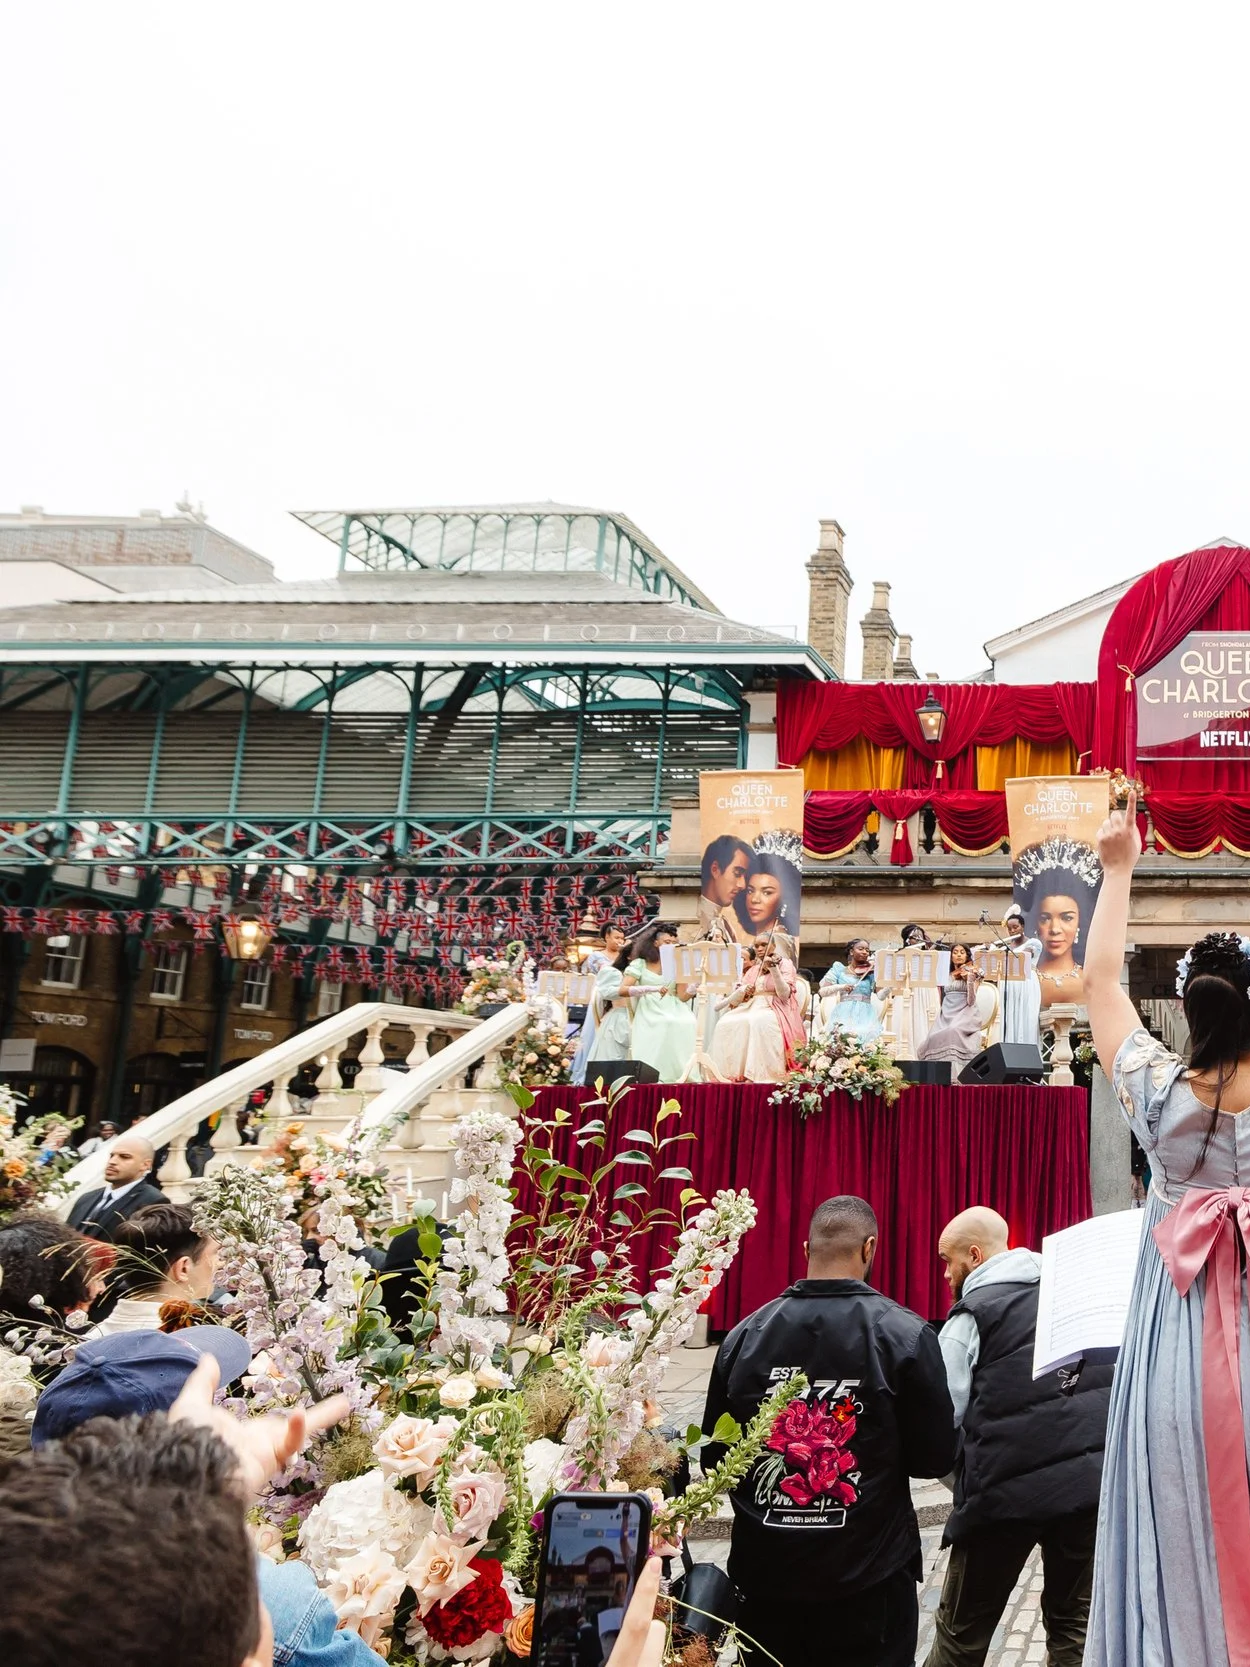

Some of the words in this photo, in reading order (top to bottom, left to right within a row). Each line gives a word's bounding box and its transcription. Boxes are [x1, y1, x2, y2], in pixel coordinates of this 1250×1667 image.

[1183, 711, 1189, 719] a
[1192, 710, 1250, 719] BRIDGERTON
[731, 783, 773, 797] QUEEN
[1037, 790, 1078, 802] QUEEN
[716, 796, 789, 809] CHARLOTTE
[1023, 802, 1093, 815] CHARLOTTE
[56, 1013, 88, 1026] FORD
[252, 1030, 274, 1041] FORD
[781, 1515, 804, 1523] NEVER
[804, 1515, 829, 1523] BREAK
